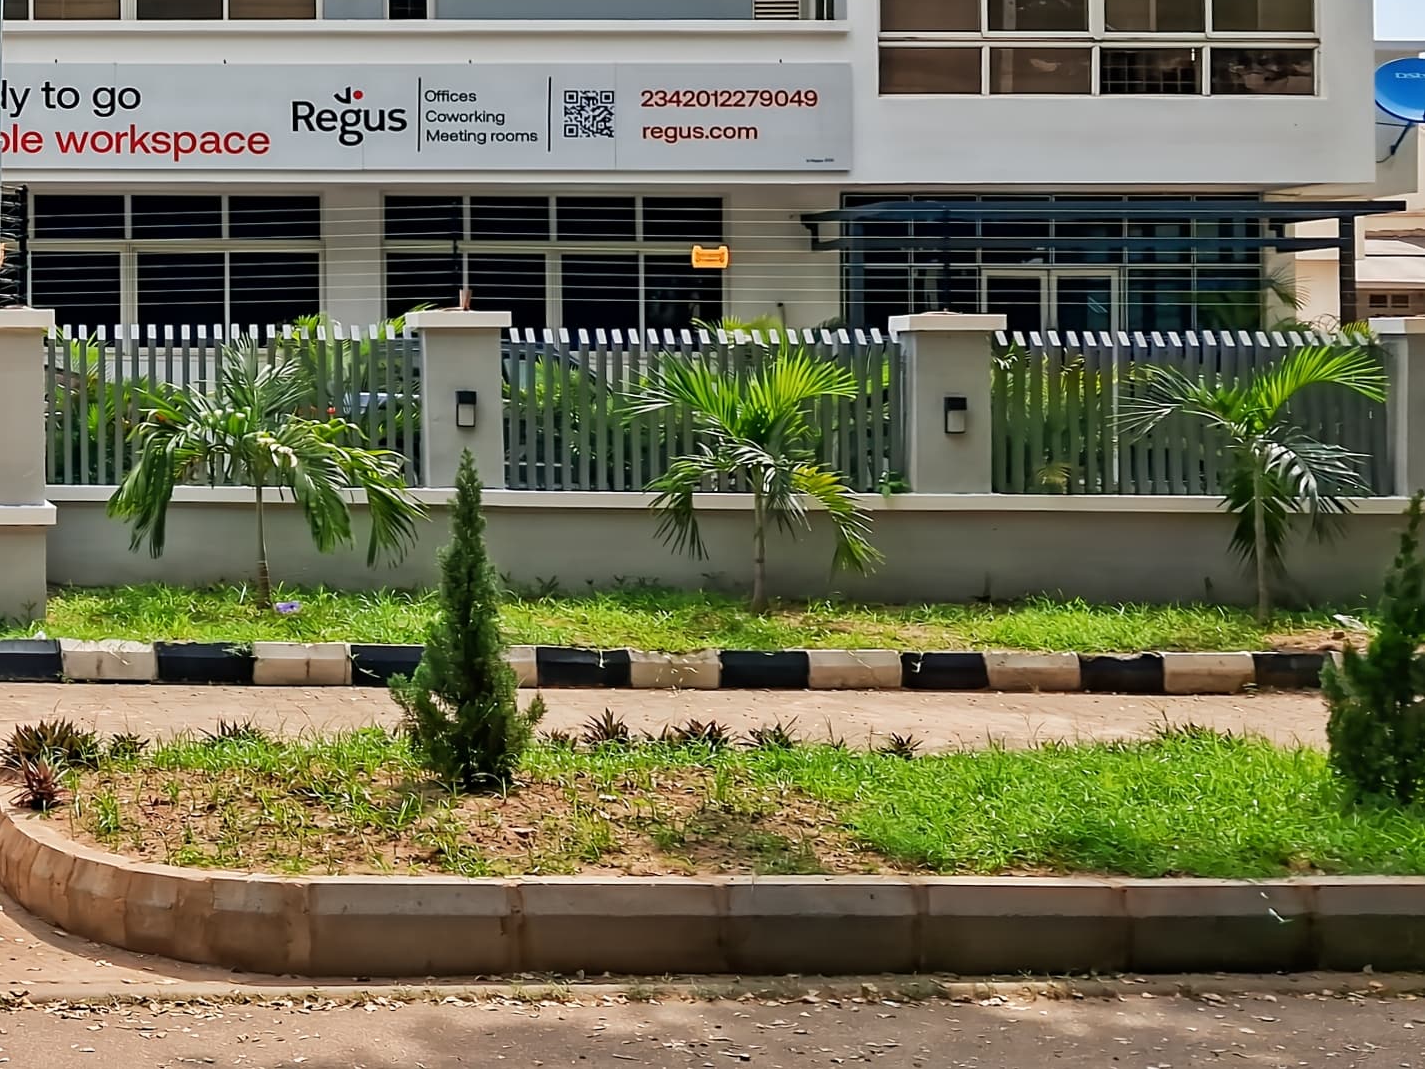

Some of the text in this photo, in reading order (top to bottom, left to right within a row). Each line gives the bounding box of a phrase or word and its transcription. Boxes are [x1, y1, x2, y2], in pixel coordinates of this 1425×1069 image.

[41, 81, 80, 109] to
[92, 86, 142, 118] go
[424, 89, 477, 103] Offices
[640, 89, 818, 108] 2342012279049
[291, 100, 407, 147] Regus
[425, 109, 506, 126] Coworking
[55, 123, 271, 162] workspace
[426, 128, 538, 145] Meeting rooms
[642, 124, 758, 143] regus.com
